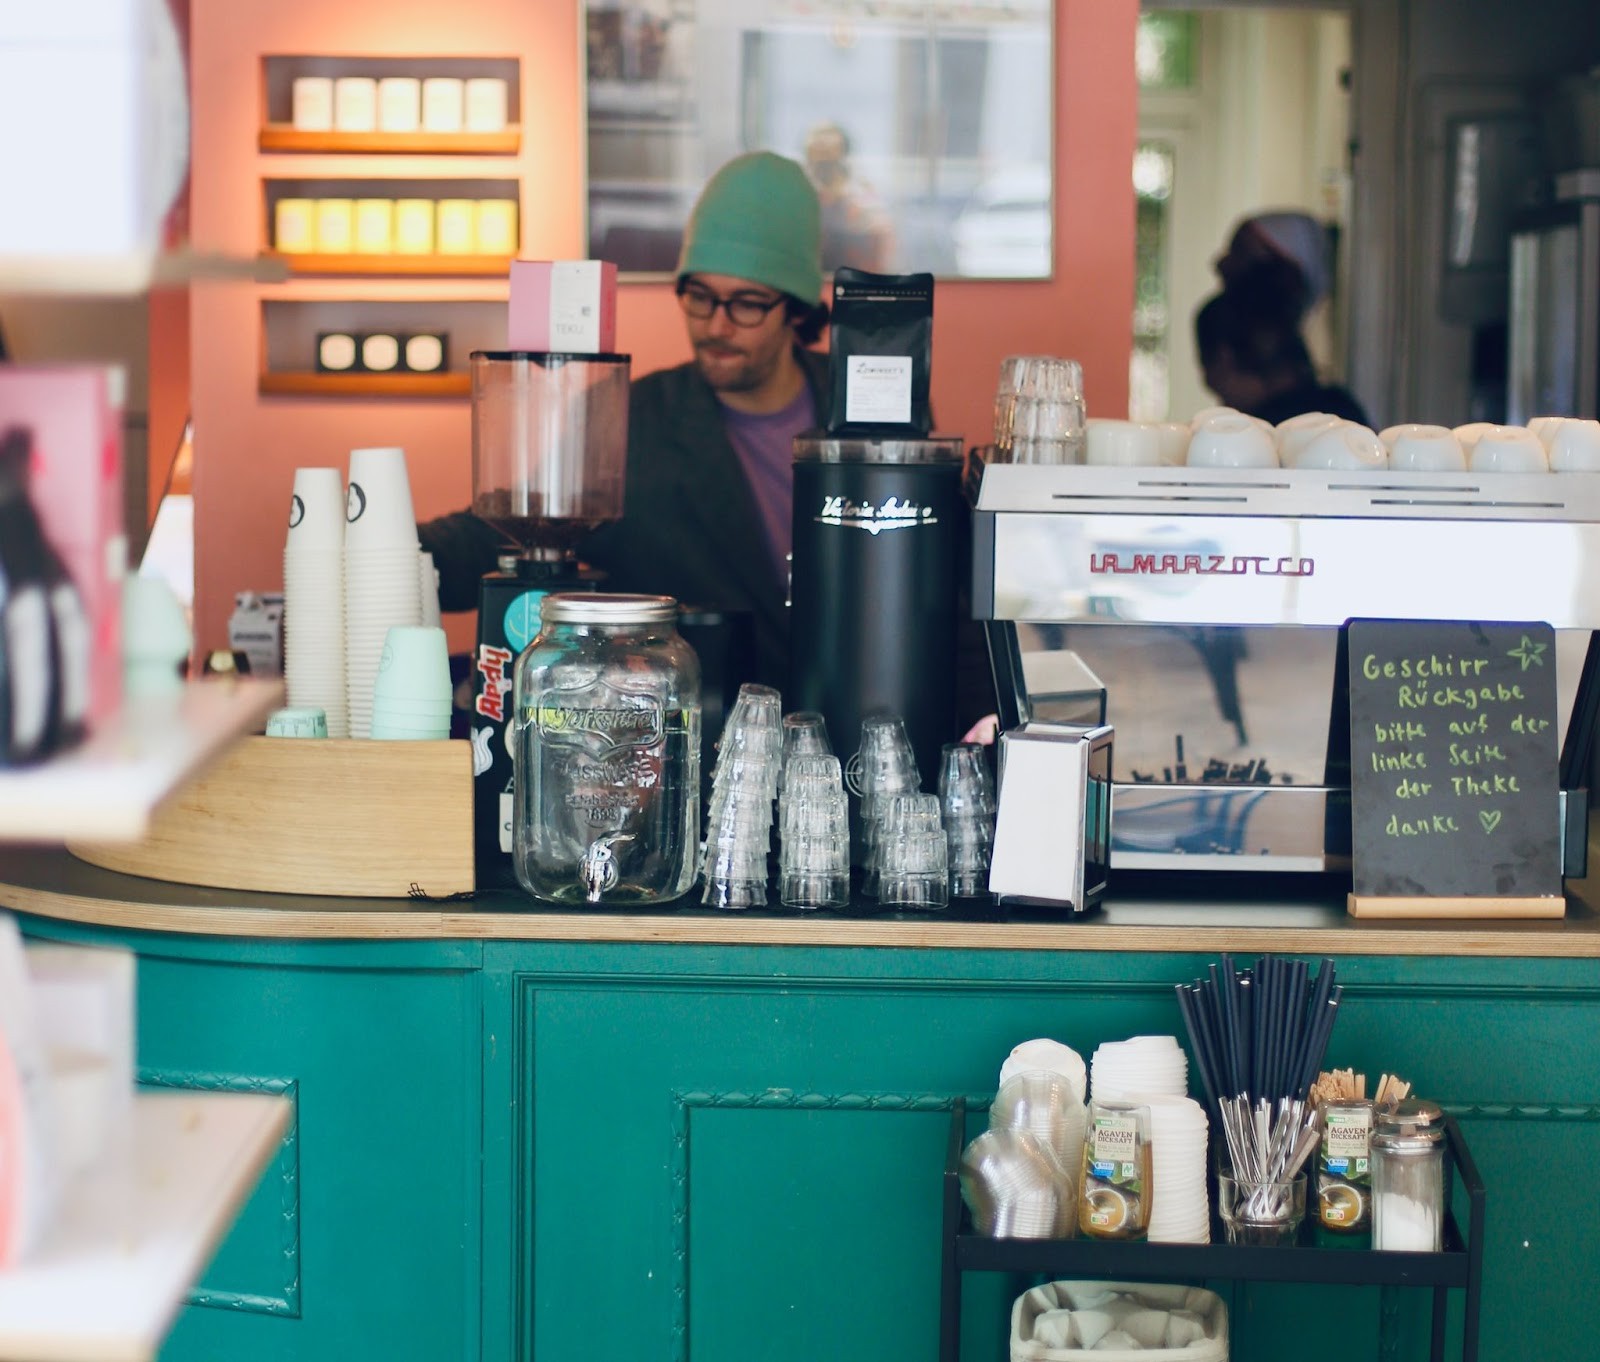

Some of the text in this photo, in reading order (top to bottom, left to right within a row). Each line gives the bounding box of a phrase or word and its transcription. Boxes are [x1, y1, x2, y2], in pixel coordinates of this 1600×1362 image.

[876, 496, 932, 518] Arduio
[1091, 553, 1118, 574] LA
[1363, 654, 1488, 680] Geschirr
[1399, 680, 1525, 709] Rückgabe
[1375, 713, 1550, 743] bitte auf der
[1372, 743, 1506, 773] linke Seite
[1395, 774, 1520, 799] der Theke
[1385, 814, 1459, 837] danke
[1098, 1129, 1133, 1138] AGAVEN
[1331, 1127, 1366, 1135] AGAVEN
